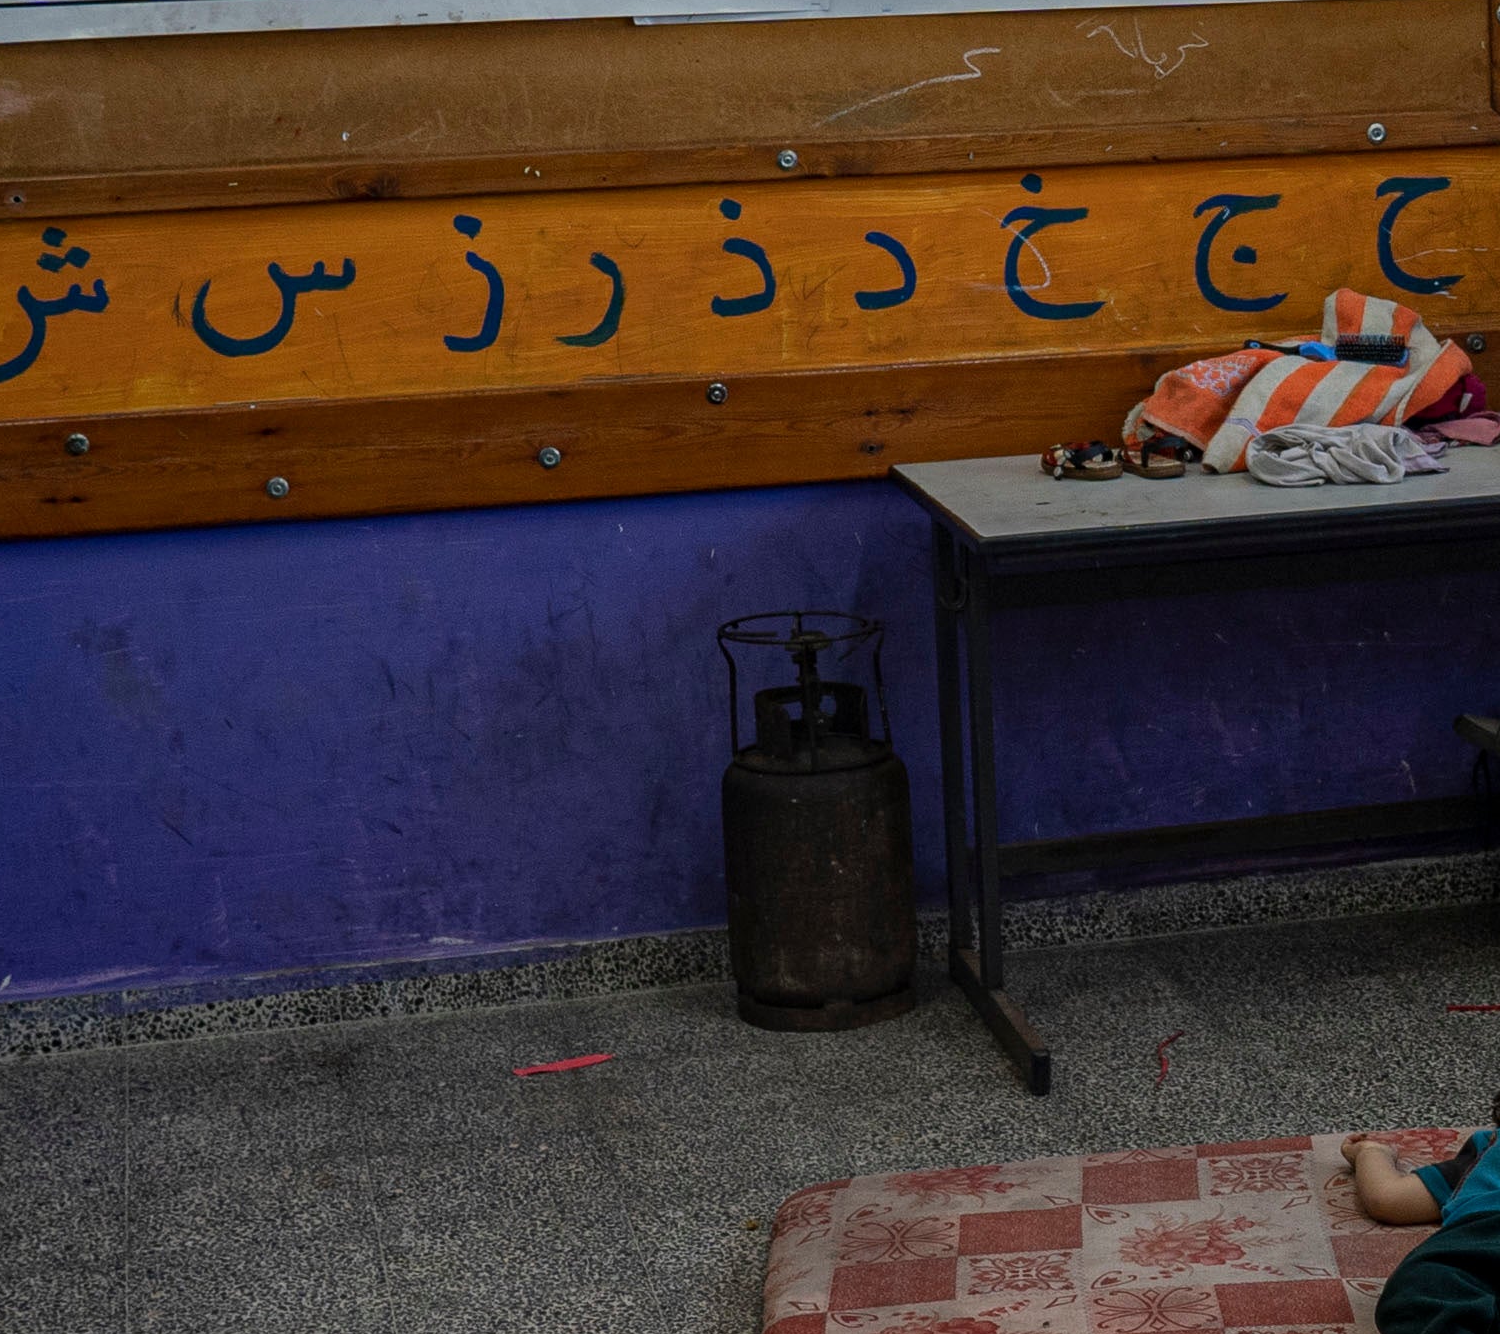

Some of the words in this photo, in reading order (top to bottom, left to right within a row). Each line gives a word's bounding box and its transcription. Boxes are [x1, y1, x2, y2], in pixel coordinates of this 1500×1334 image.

[444, 215, 504, 353] ز
[712, 199, 775, 318] ذ
[856, 231, 916, 310] د
[1002, 174, 1104, 320] خ
[1195, 194, 1286, 312] ج
[1377, 177, 1460, 294] ح
[191, 257, 355, 357] س
[558, 252, 624, 346] ر
